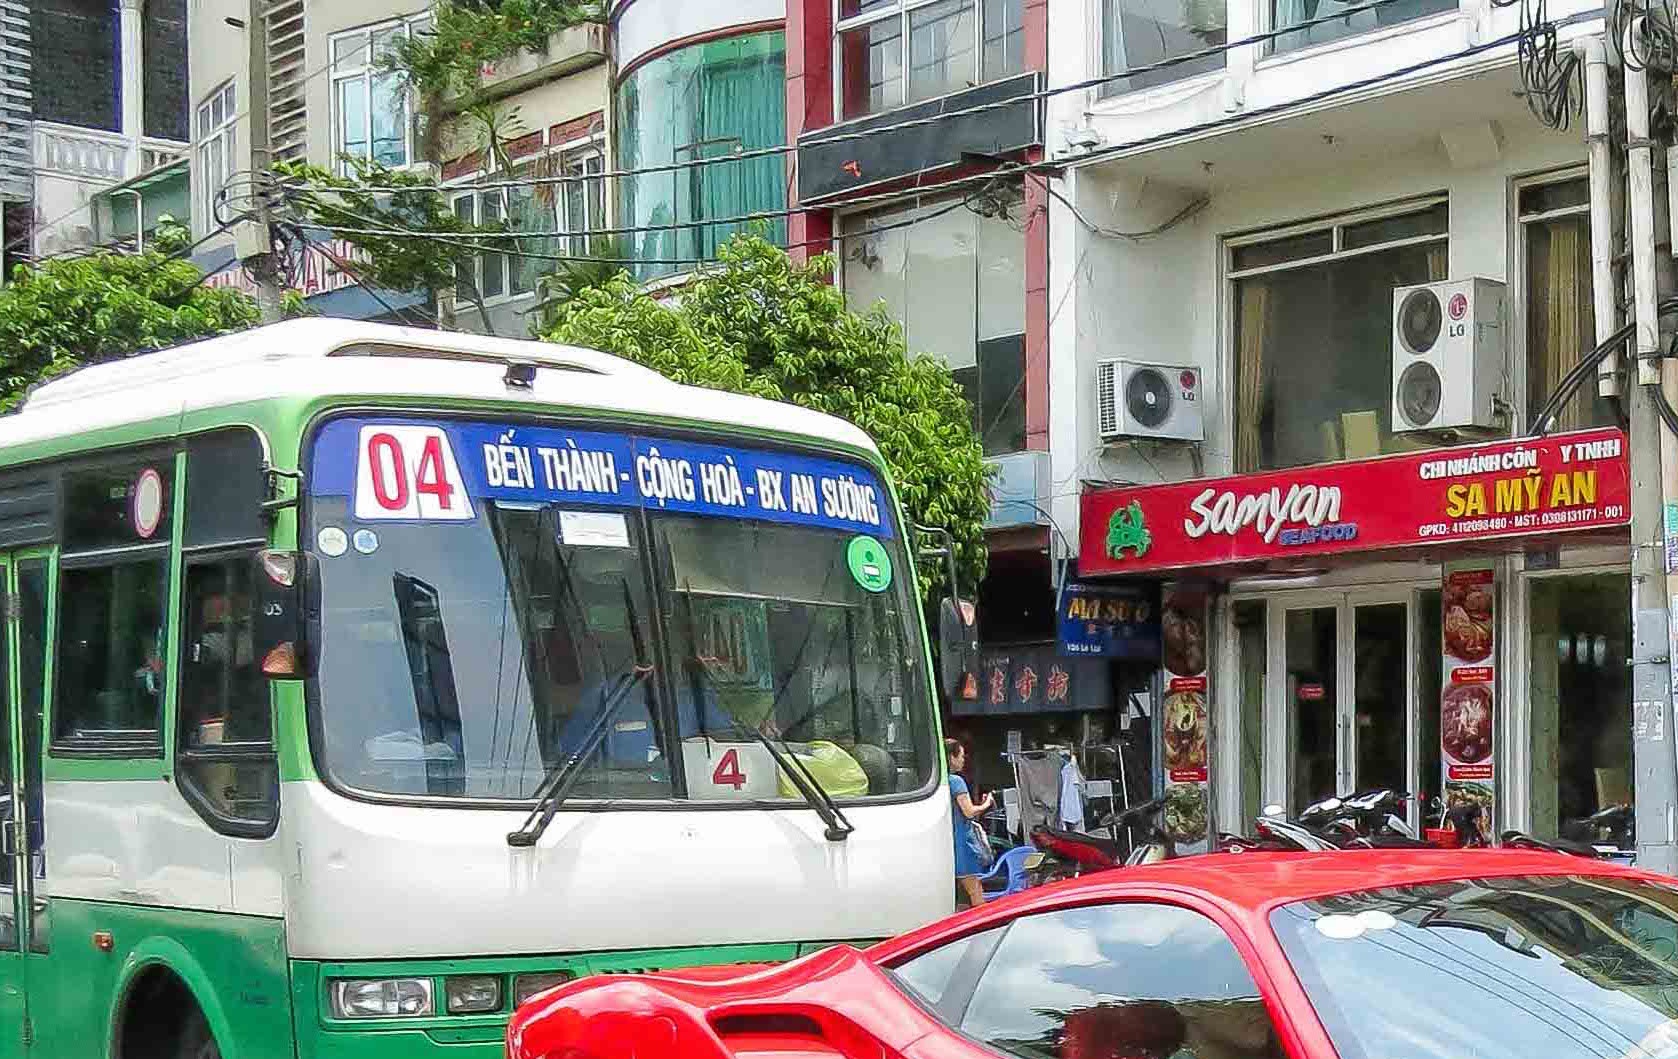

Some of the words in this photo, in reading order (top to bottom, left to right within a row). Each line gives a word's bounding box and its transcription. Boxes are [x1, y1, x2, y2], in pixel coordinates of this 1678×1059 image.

[1450, 324, 1465, 337] LG
[368, 433, 454, 511] 04
[483, 429, 534, 489] BẾN
[538, 437, 618, 494] THÀNH
[636, 447, 695, 507] CỘNG
[700, 455, 746, 507] HOÀ
[756, 467, 788, 512] BX
[790, 473, 818, 515] AN
[1419, 461, 1447, 480] CHI
[1447, 452, 1502, 477] NHÁNH
[1575, 439, 1621, 462] TNHH
[1446, 481, 1489, 518] SA
[1495, 467, 1542, 513] MỸ
[1550, 470, 1598, 508] AN
[1605, 504, 1623, 519] 001
[1279, 523, 1358, 546] SEAFOOD
[713, 748, 746, 791] 4
